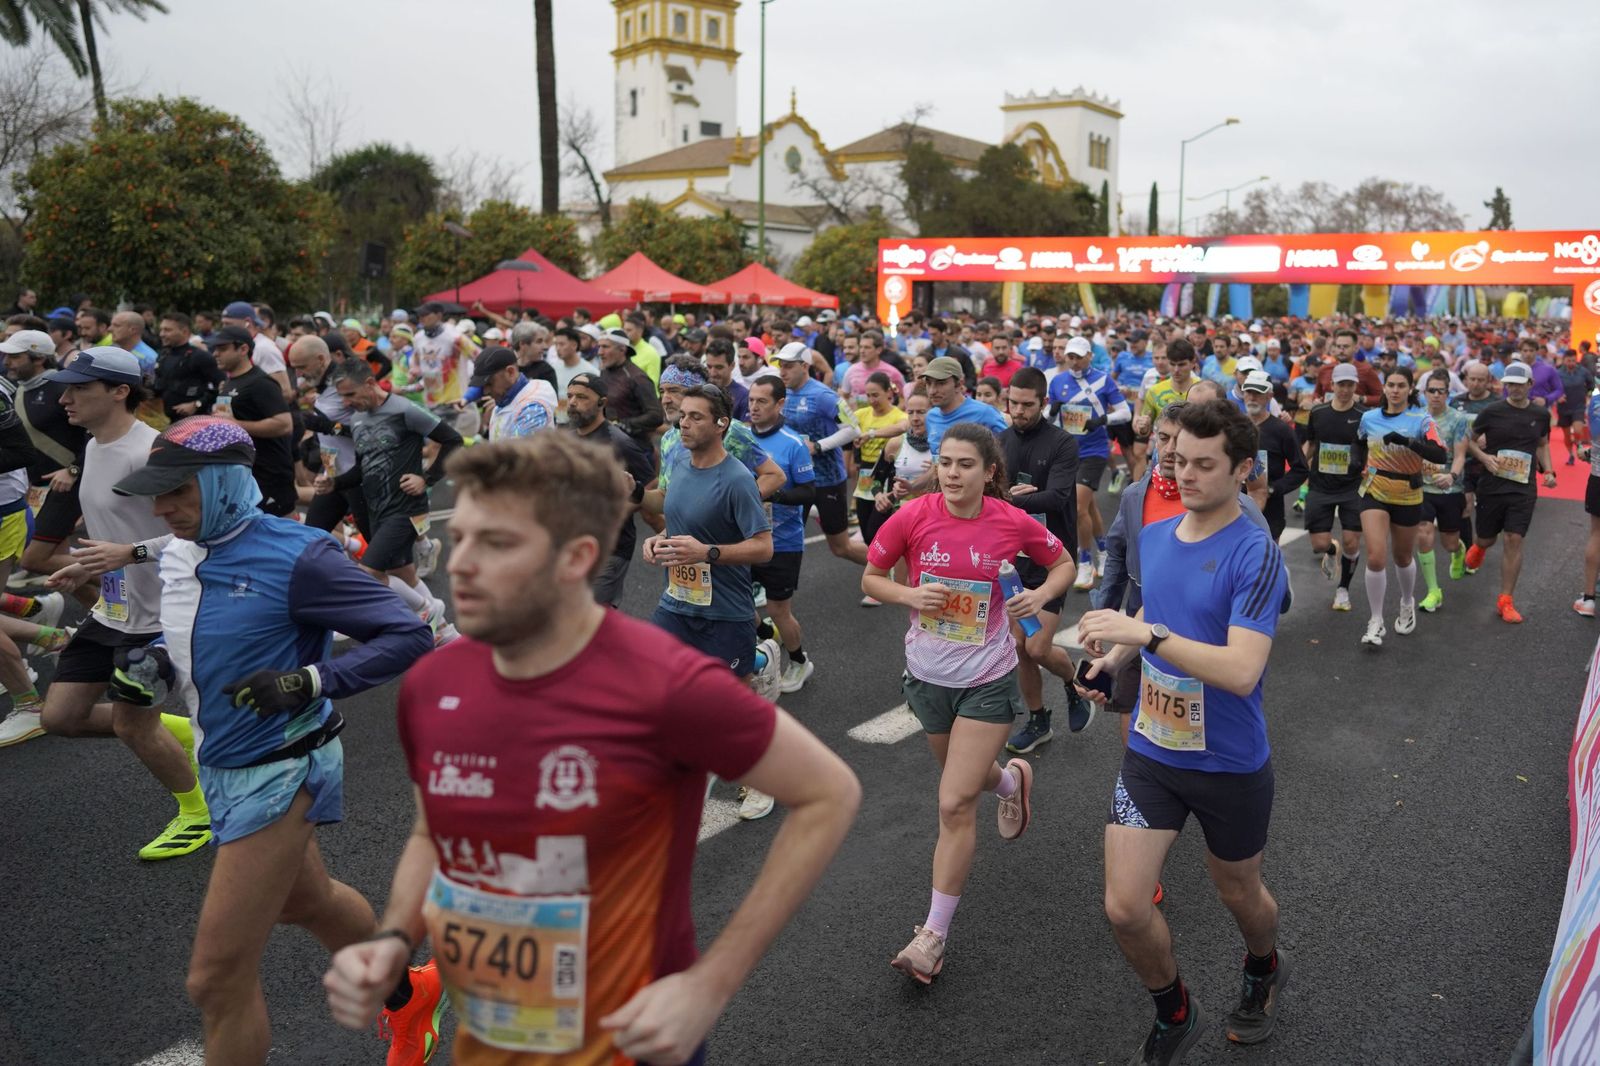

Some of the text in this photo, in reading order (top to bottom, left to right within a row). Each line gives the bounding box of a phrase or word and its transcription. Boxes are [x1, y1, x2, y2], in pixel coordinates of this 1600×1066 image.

[1503, 456, 1525, 469] 7331
[1147, 684, 1186, 718] 8175
[444, 921, 539, 981] 5740
